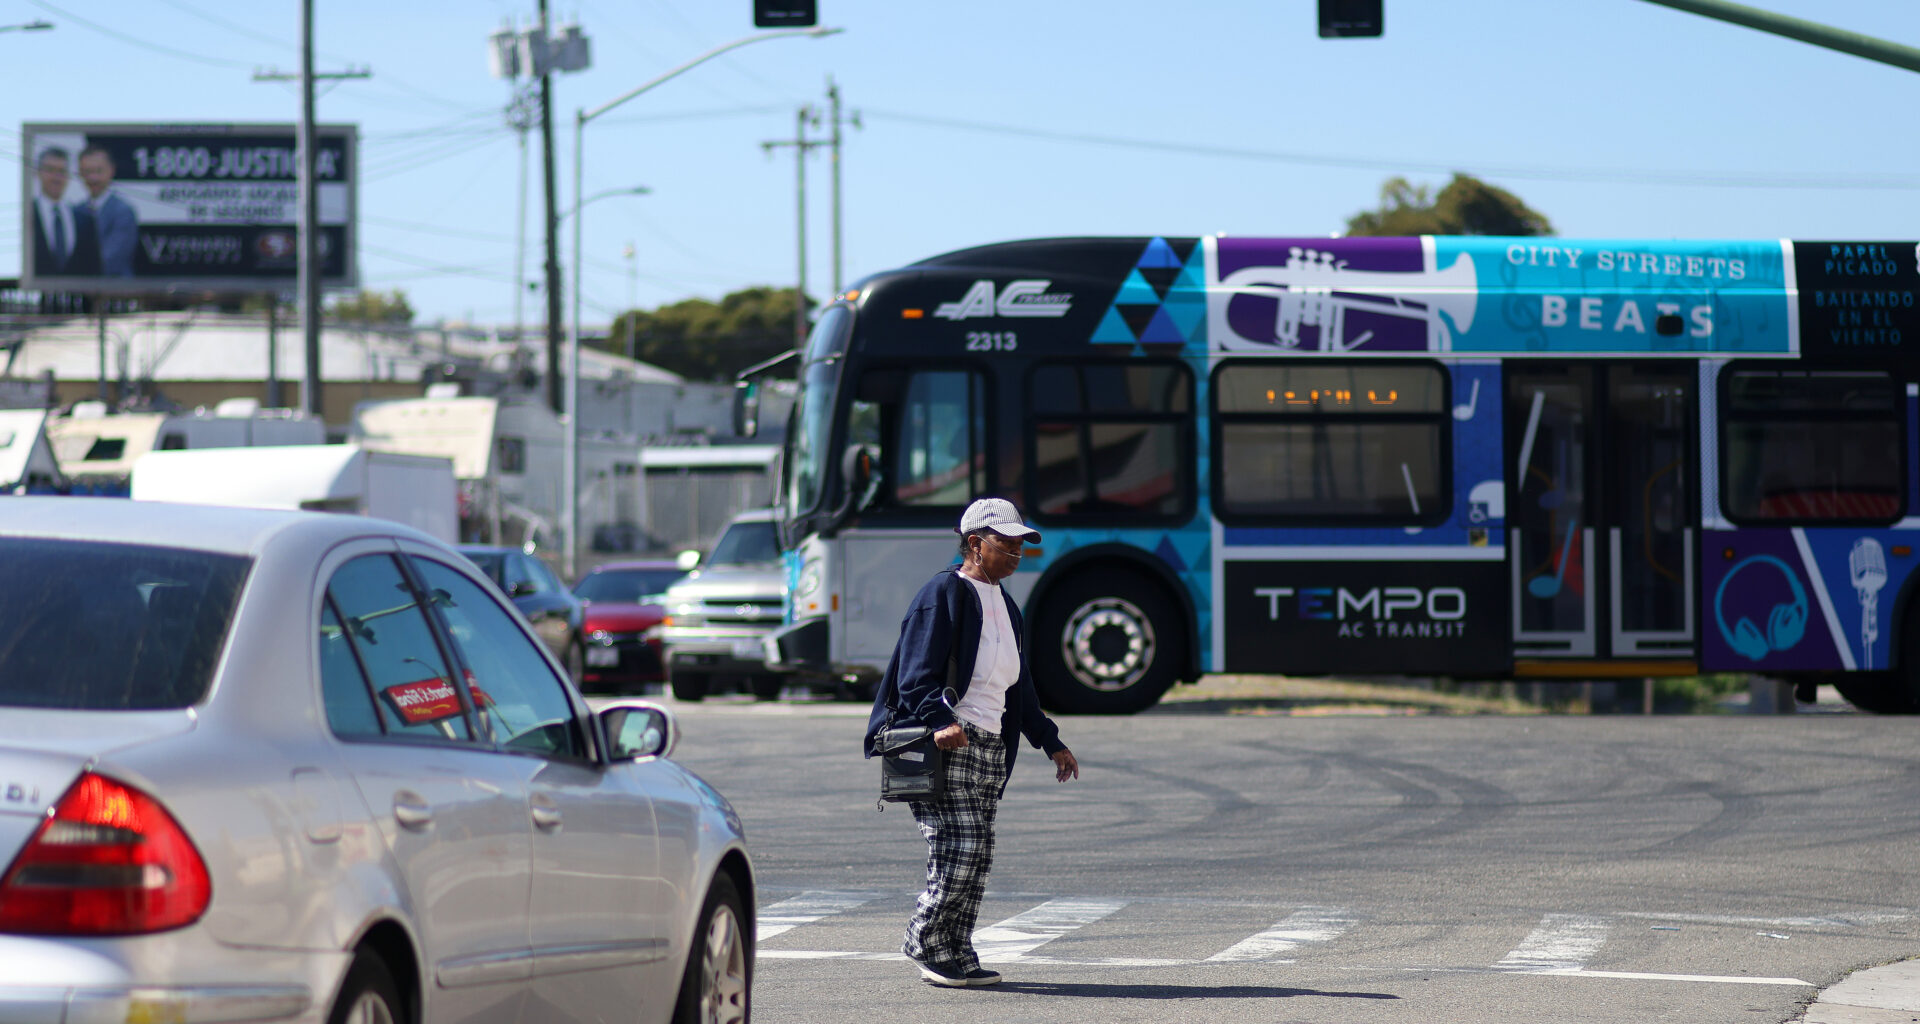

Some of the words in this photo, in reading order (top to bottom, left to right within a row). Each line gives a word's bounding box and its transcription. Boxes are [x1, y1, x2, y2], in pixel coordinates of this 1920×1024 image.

[1830, 244, 1889, 260] PAPEL
[1506, 245, 1583, 269] CITY
[1597, 250, 1746, 280] STREETS
[1824, 259, 1898, 276] PICADO
[1815, 290, 1914, 308] BAILANDO
[1838, 309, 1862, 327] EN
[1873, 309, 1893, 327] EL
[966, 332, 1018, 351] 2313
[1831, 328, 1902, 346] VIENTO
[1254, 588, 1466, 620] TEMPO
[1338, 622, 1365, 638] AC
[1375, 622, 1466, 638] TRANSIT
